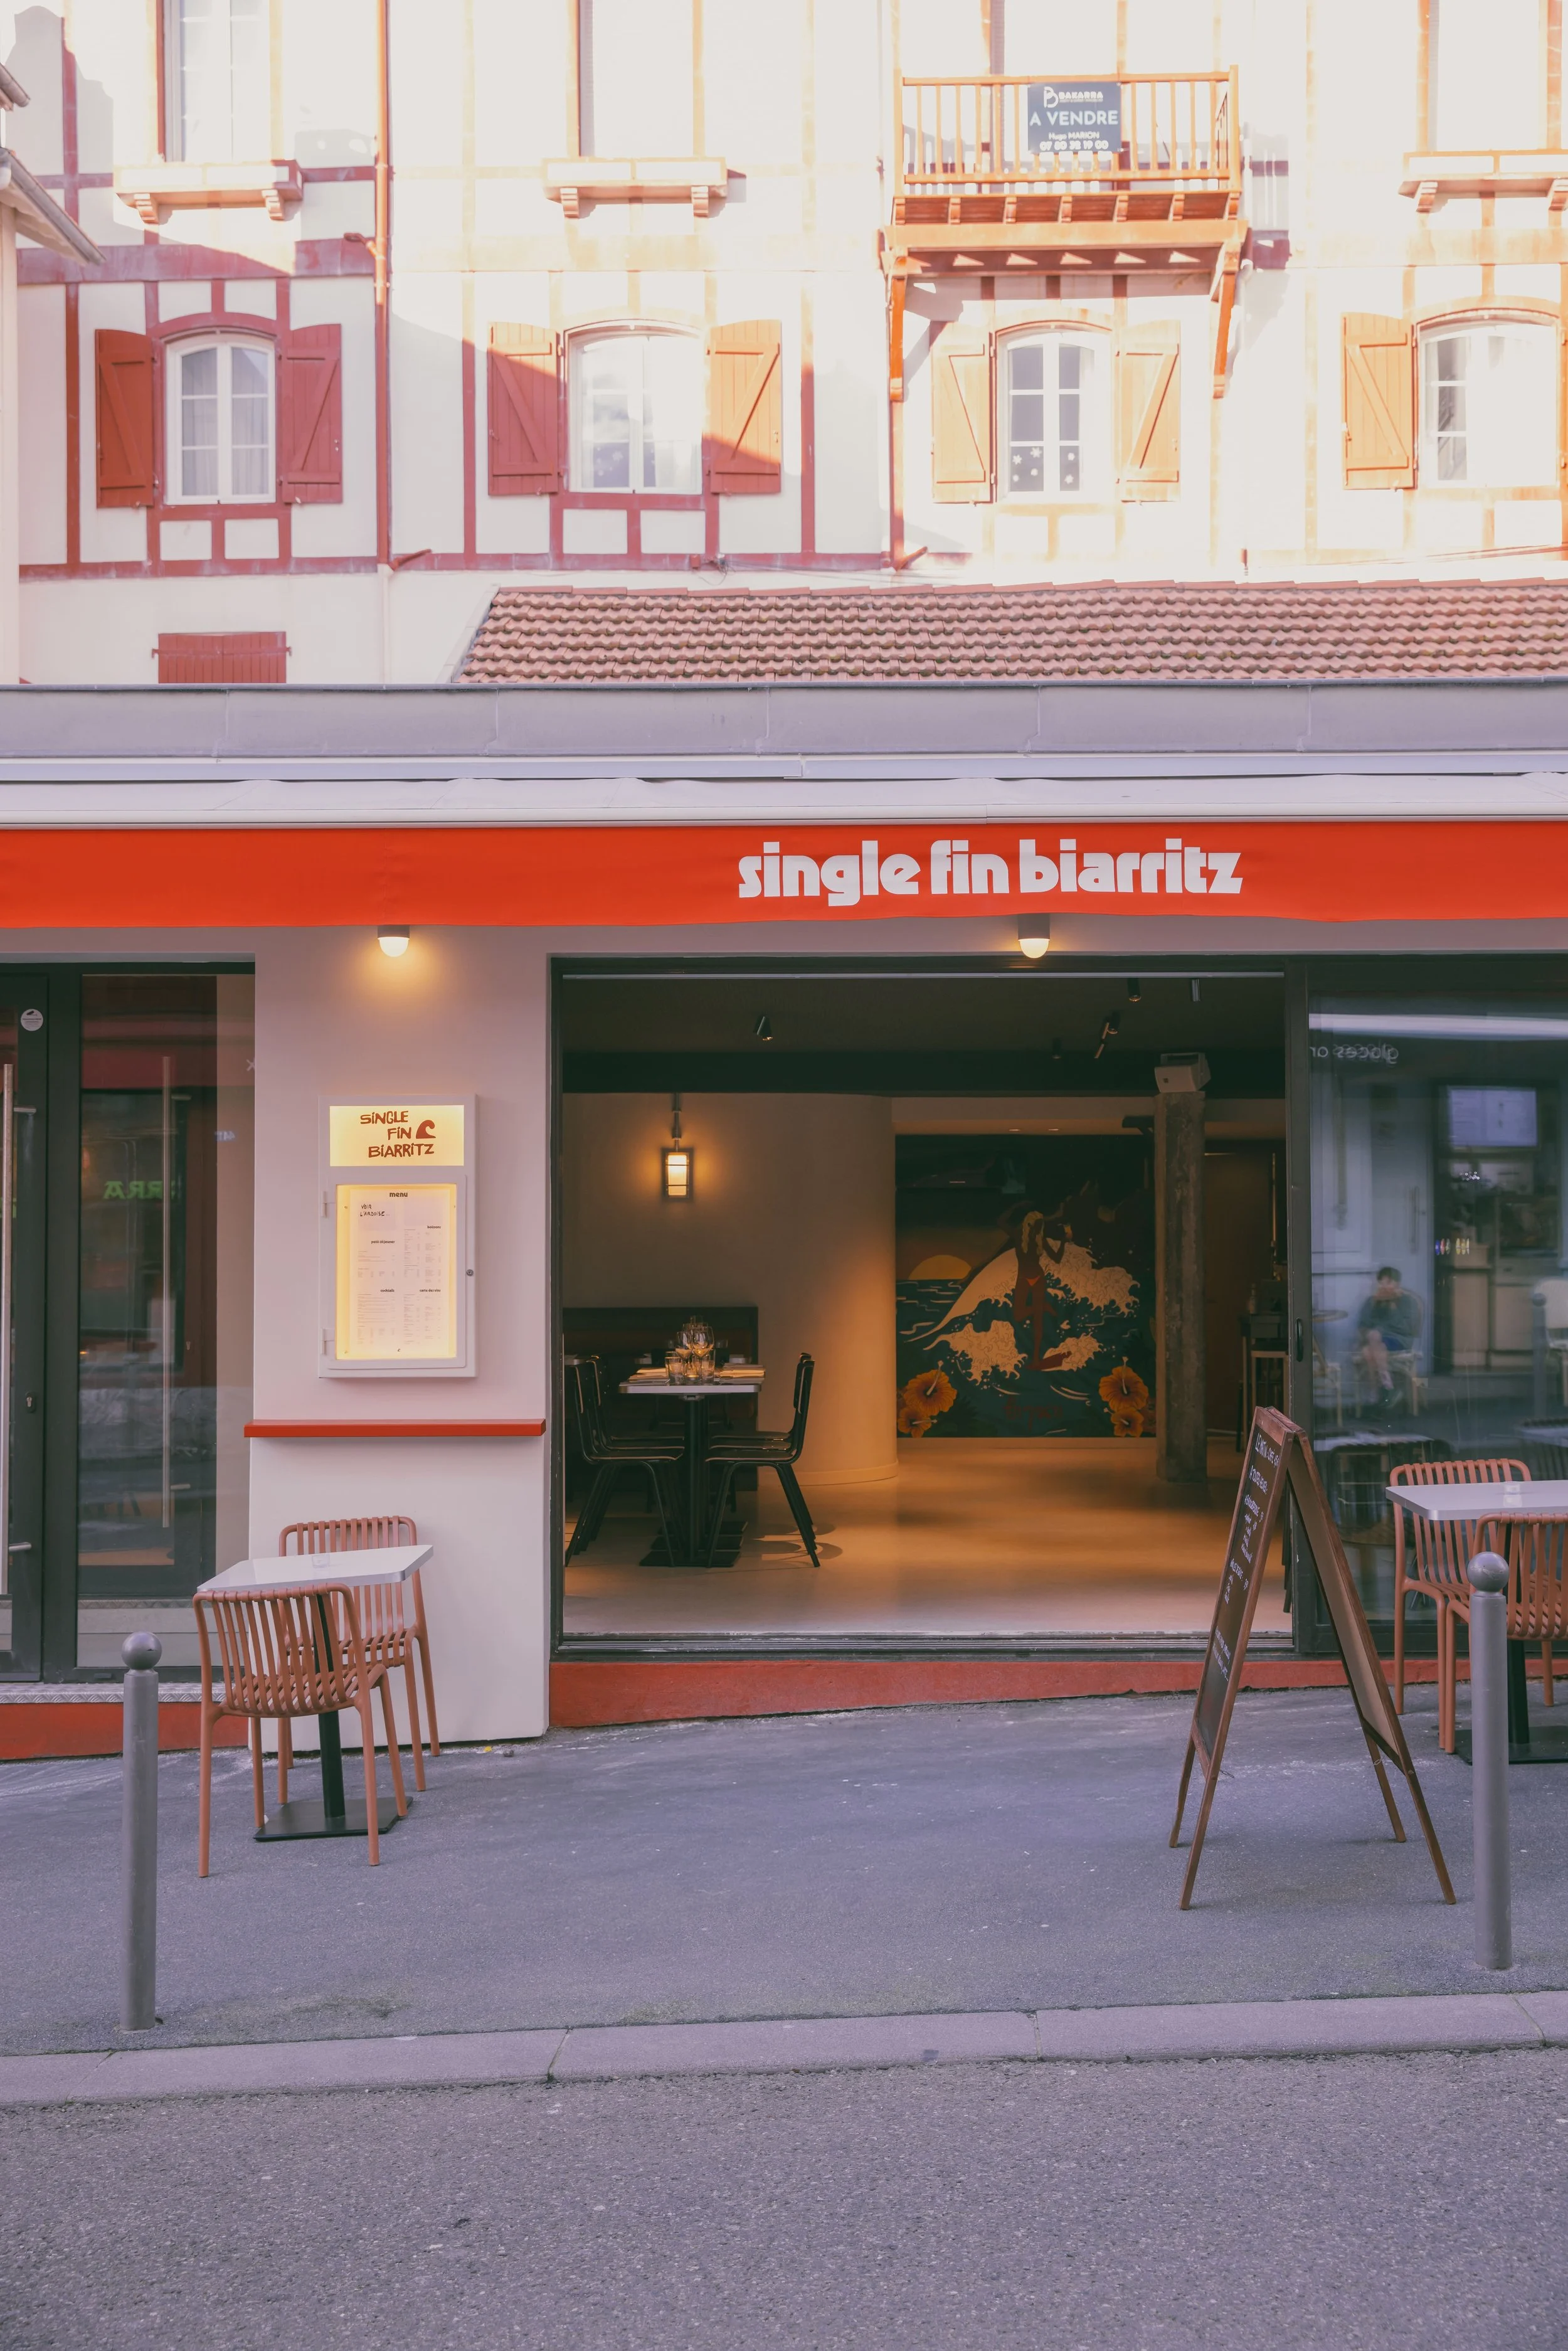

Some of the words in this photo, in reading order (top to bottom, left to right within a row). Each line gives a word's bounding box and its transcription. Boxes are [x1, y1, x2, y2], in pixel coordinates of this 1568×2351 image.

[1029, 112, 1041, 126] A
[1046, 110, 1118, 126] VENDRE
[1049, 132, 1067, 141] Hugo
[1068, 131, 1100, 139] MARION
[1039, 141, 1052, 151] 07
[1094, 141, 1108, 151] 00
[739, 841, 921, 906] single
[931, 840, 1010, 894] fin
[1020, 839, 1244, 894] biarritz
